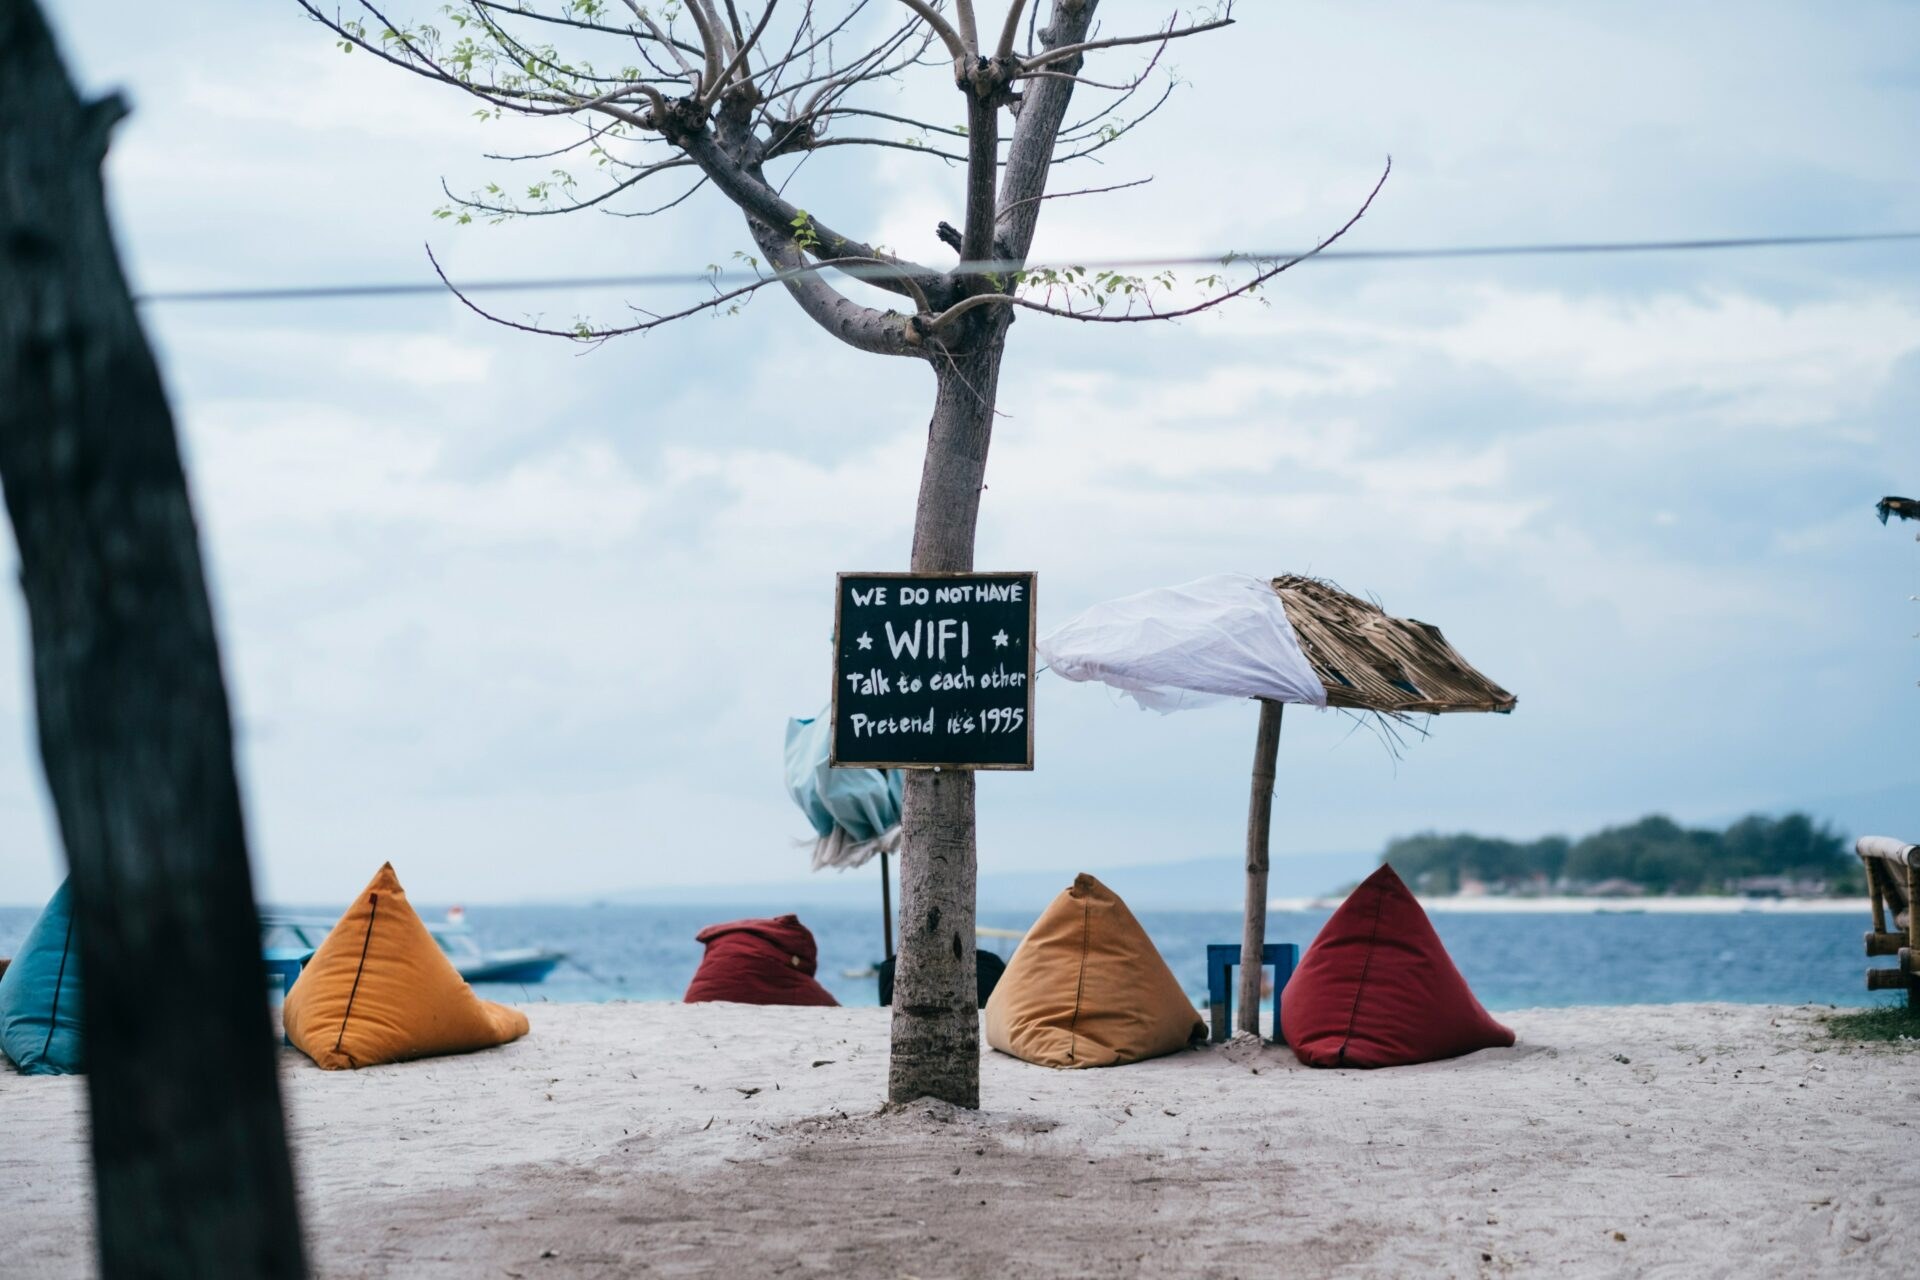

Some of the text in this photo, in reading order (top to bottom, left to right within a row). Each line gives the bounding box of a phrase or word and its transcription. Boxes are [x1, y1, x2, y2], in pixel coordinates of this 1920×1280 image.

[851, 582, 1024, 607] WE DO NOT HAVE
[884, 618, 969, 660] WIFI
[846, 662, 1026, 696] Talk to each other
[850, 706, 935, 738] Pretend
[979, 706, 1025, 734] 1995
